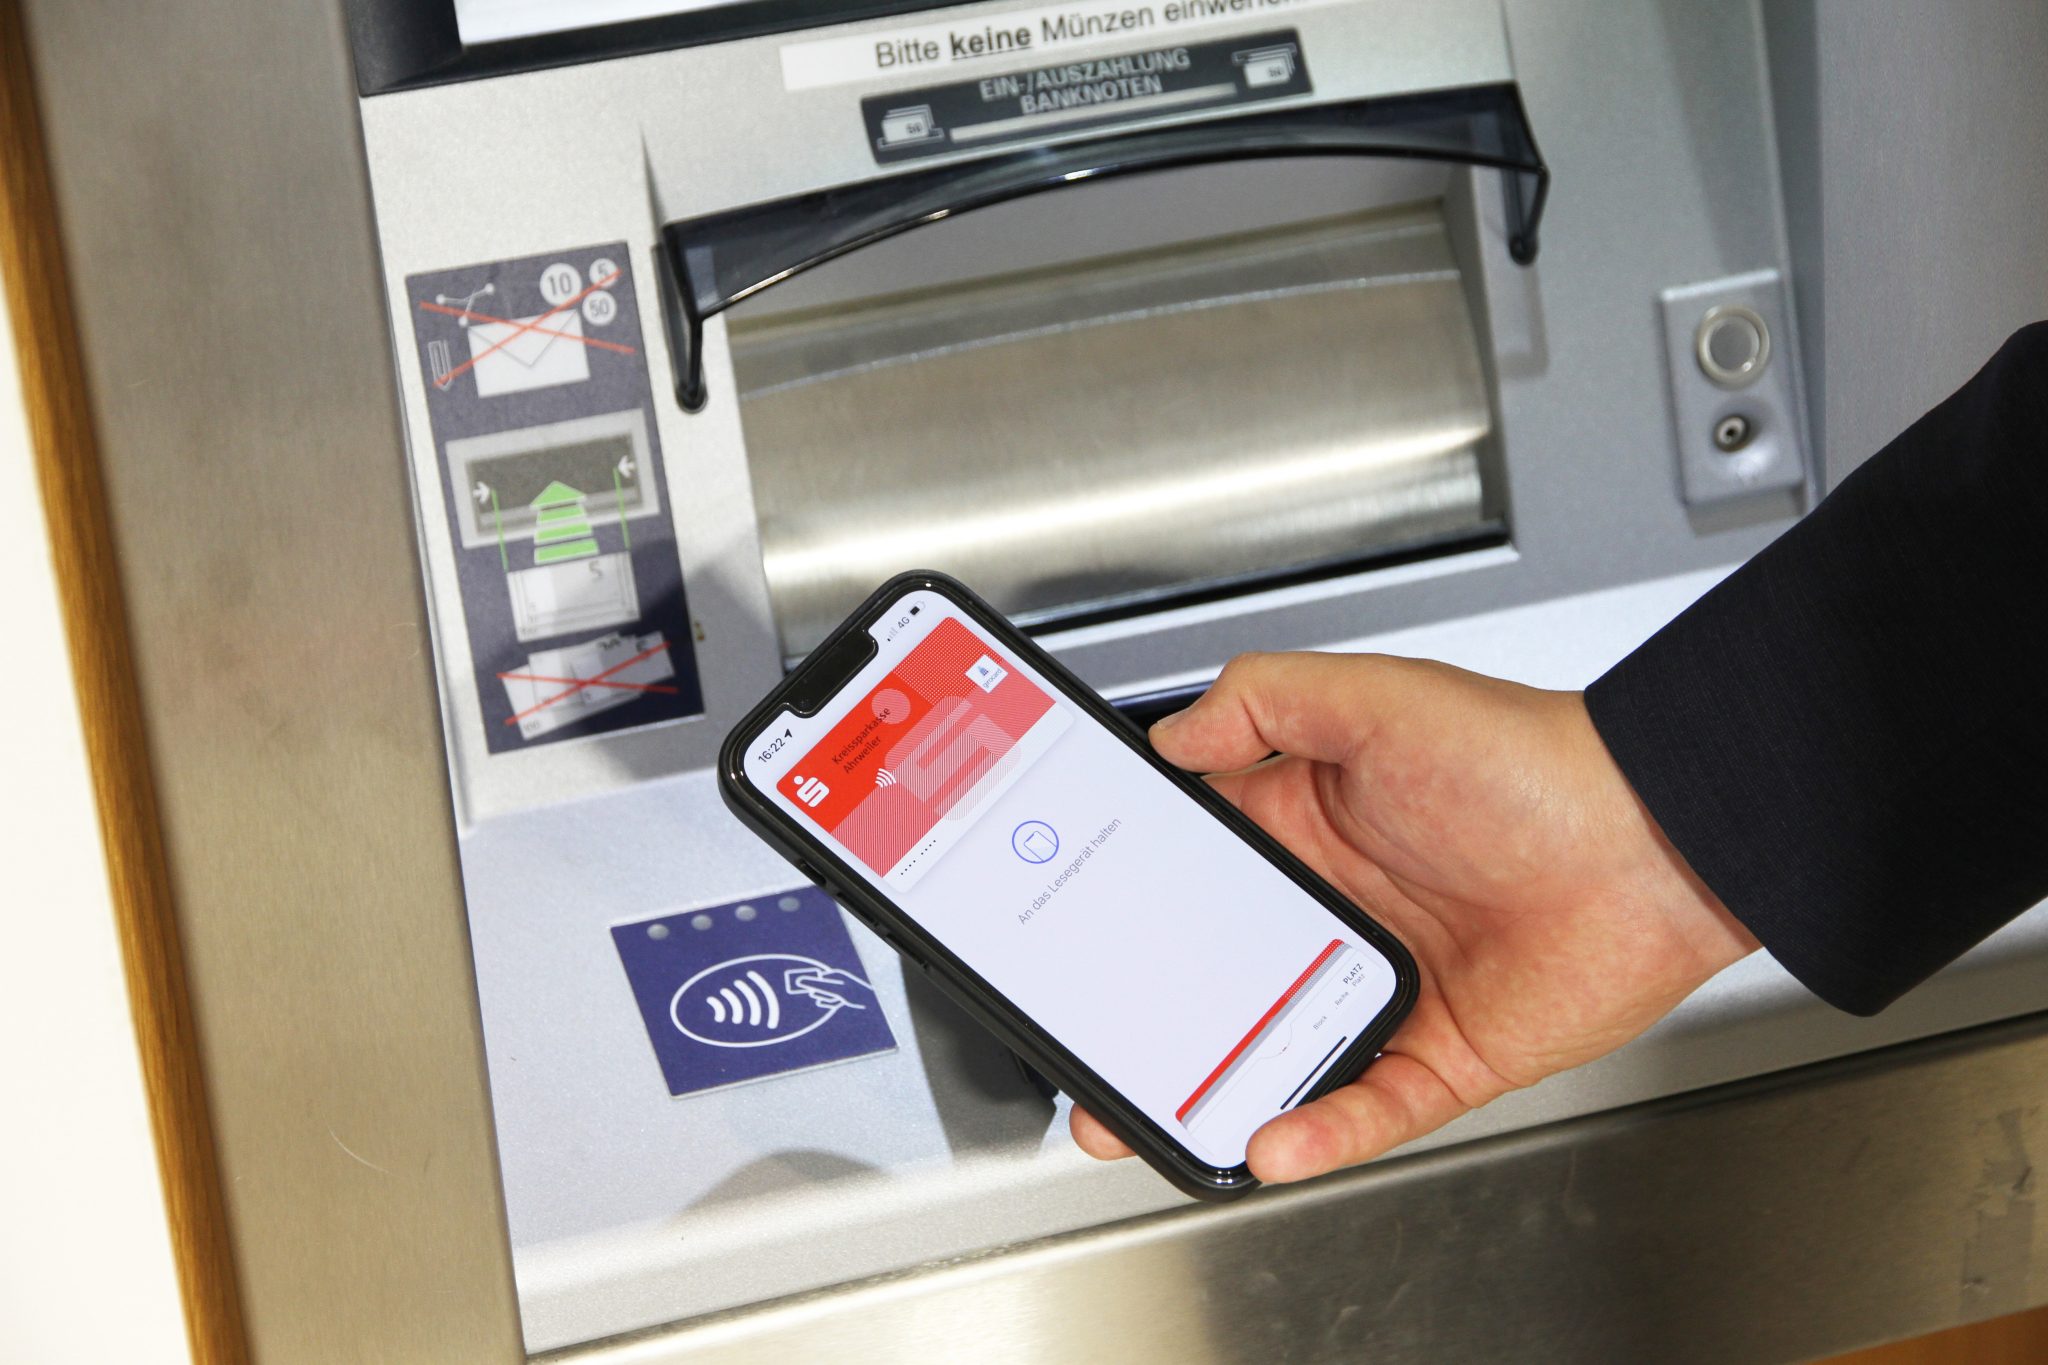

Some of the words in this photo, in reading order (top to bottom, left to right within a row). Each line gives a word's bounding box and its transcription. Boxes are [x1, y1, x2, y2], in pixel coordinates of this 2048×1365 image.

[875, 40, 939, 68] Bitte
[950, 27, 1031, 58] keine
[1041, 7, 1154, 42] Münzen
[978, 47, 1191, 101] EIN-/AUSZAHLUNG
[1020, 74, 1164, 115] BANKNOTEN
[547, 271, 572, 297] 10
[897, 616, 910, 629] 4G
[758, 737, 786, 763] 16:22
[831, 708, 891, 765] Kreissparkasse
[843, 736, 881, 774] Ahrweiler
[1018, 908, 1034, 925] An
[1032, 890, 1052, 911] das
[1047, 845, 1095, 894] Lesegerät
[1090, 817, 1122, 848] halten
[1342, 962, 1363, 985] PLATZ
